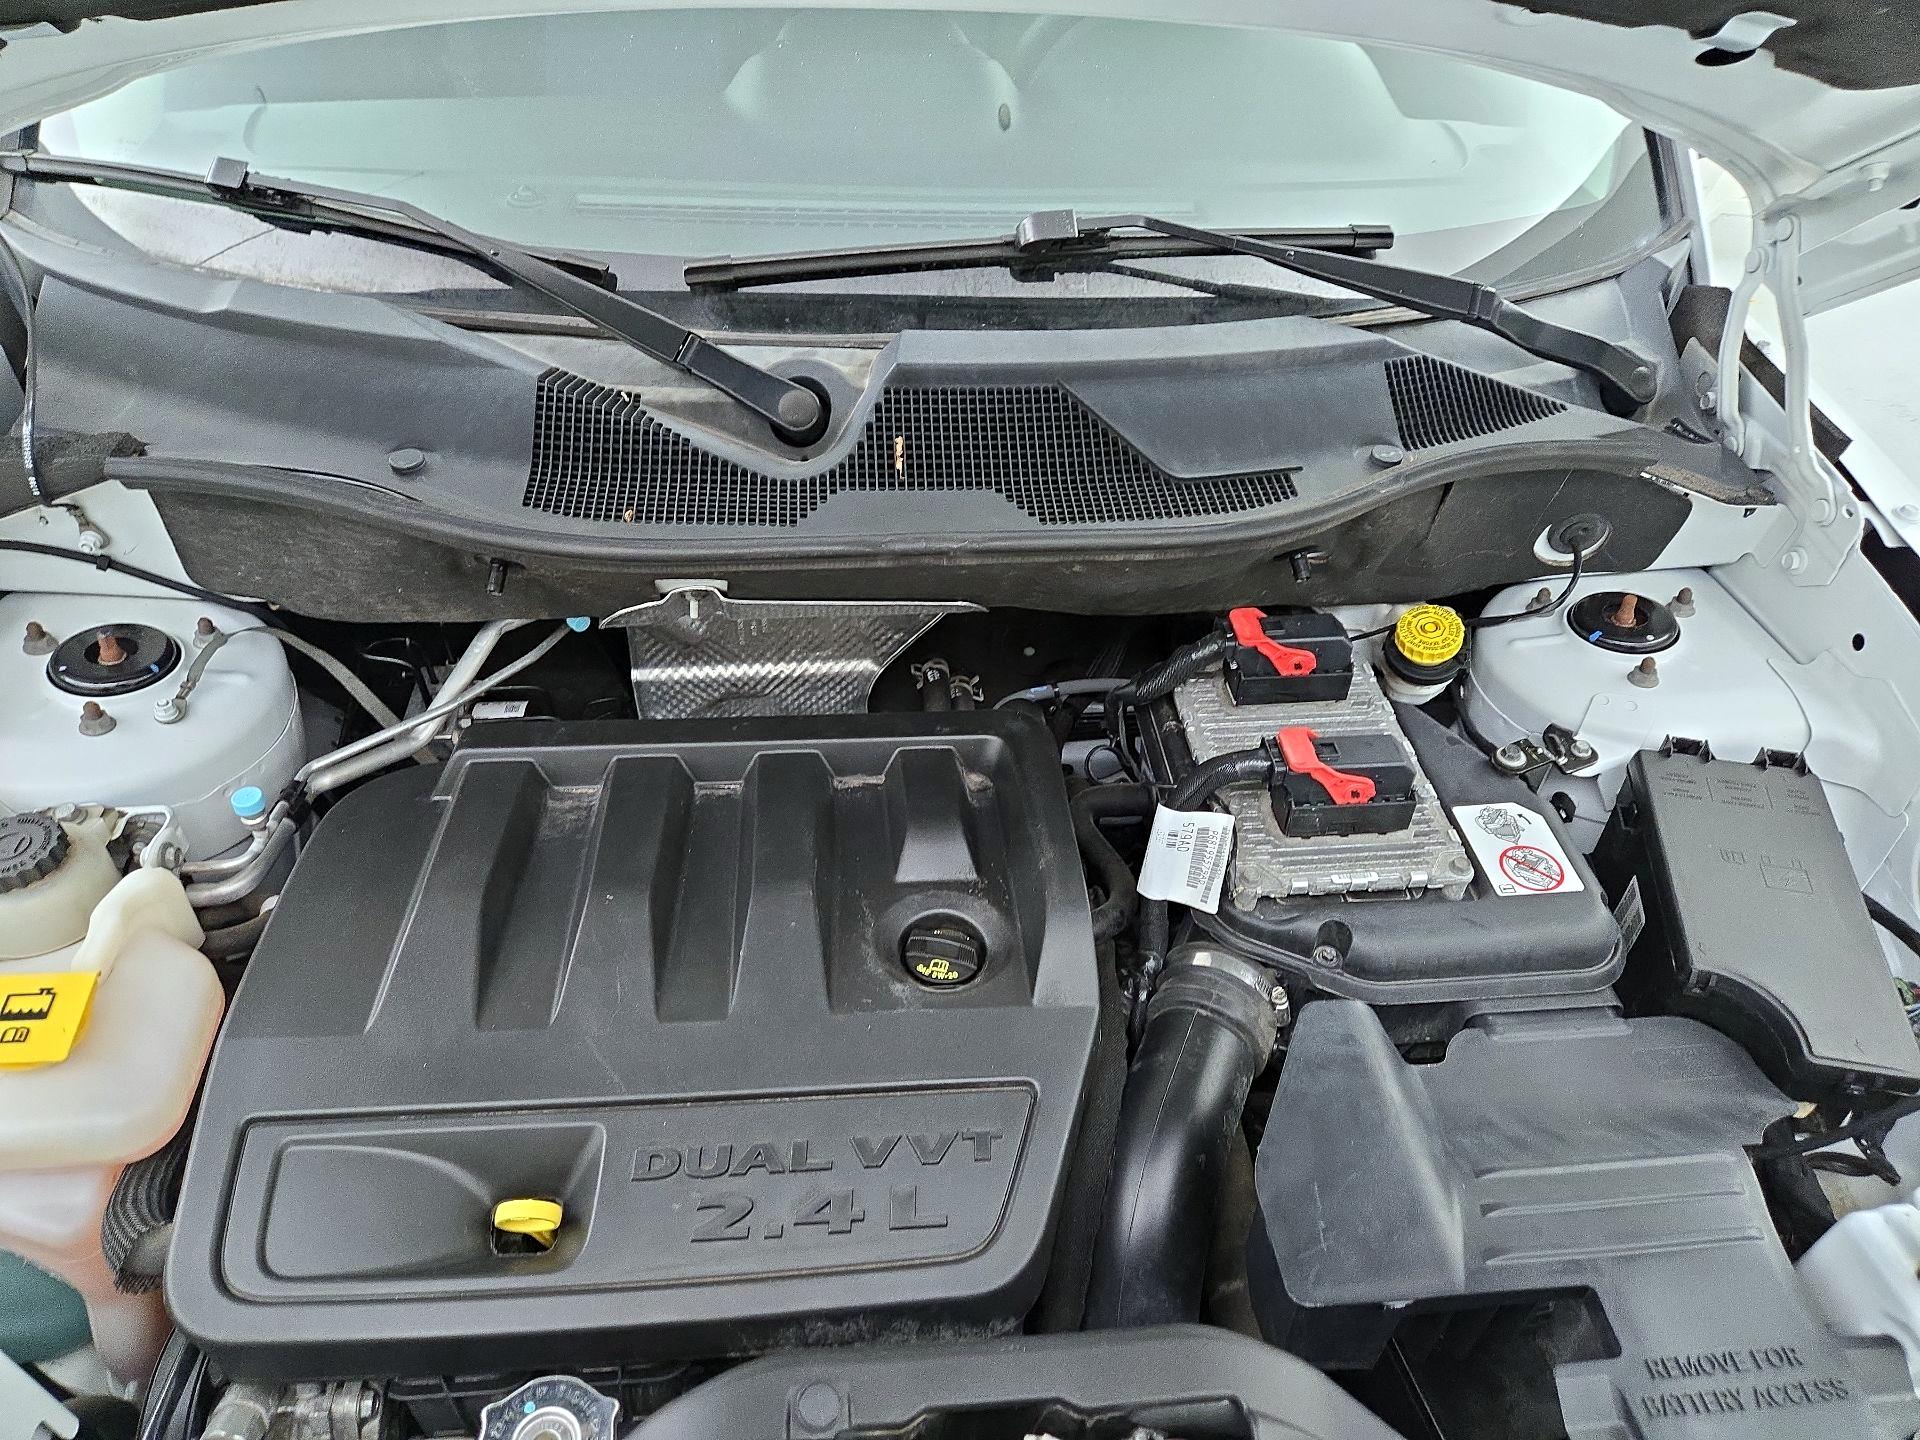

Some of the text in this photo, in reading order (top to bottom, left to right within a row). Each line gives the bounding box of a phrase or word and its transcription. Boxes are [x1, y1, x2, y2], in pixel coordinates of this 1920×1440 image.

[631, 1129, 1003, 1183] DUAL VVT
[1643, 1345, 1803, 1381] REMOVE FOR
[1641, 1376, 1849, 1418] BATTERY ACCESS
